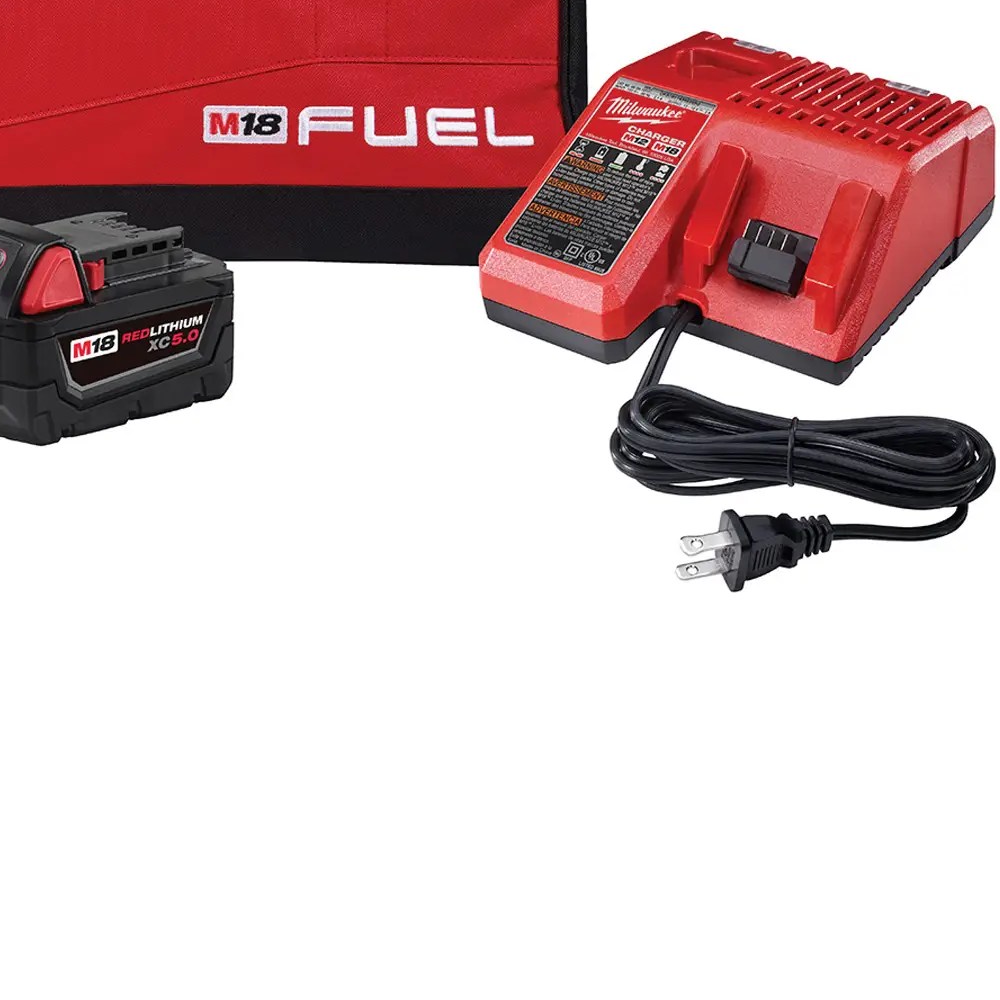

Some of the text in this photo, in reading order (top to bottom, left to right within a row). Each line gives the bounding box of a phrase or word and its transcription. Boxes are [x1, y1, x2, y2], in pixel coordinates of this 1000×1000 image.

[606, 97, 684, 119] Milwaukee
[208, 106, 535, 147] M18 FUEL
[627, 125, 687, 148] CHARGER
[622, 132, 650, 147] M12
[653, 141, 680, 156] M18
[73, 314, 204, 359] M18 REDLITHIUM
